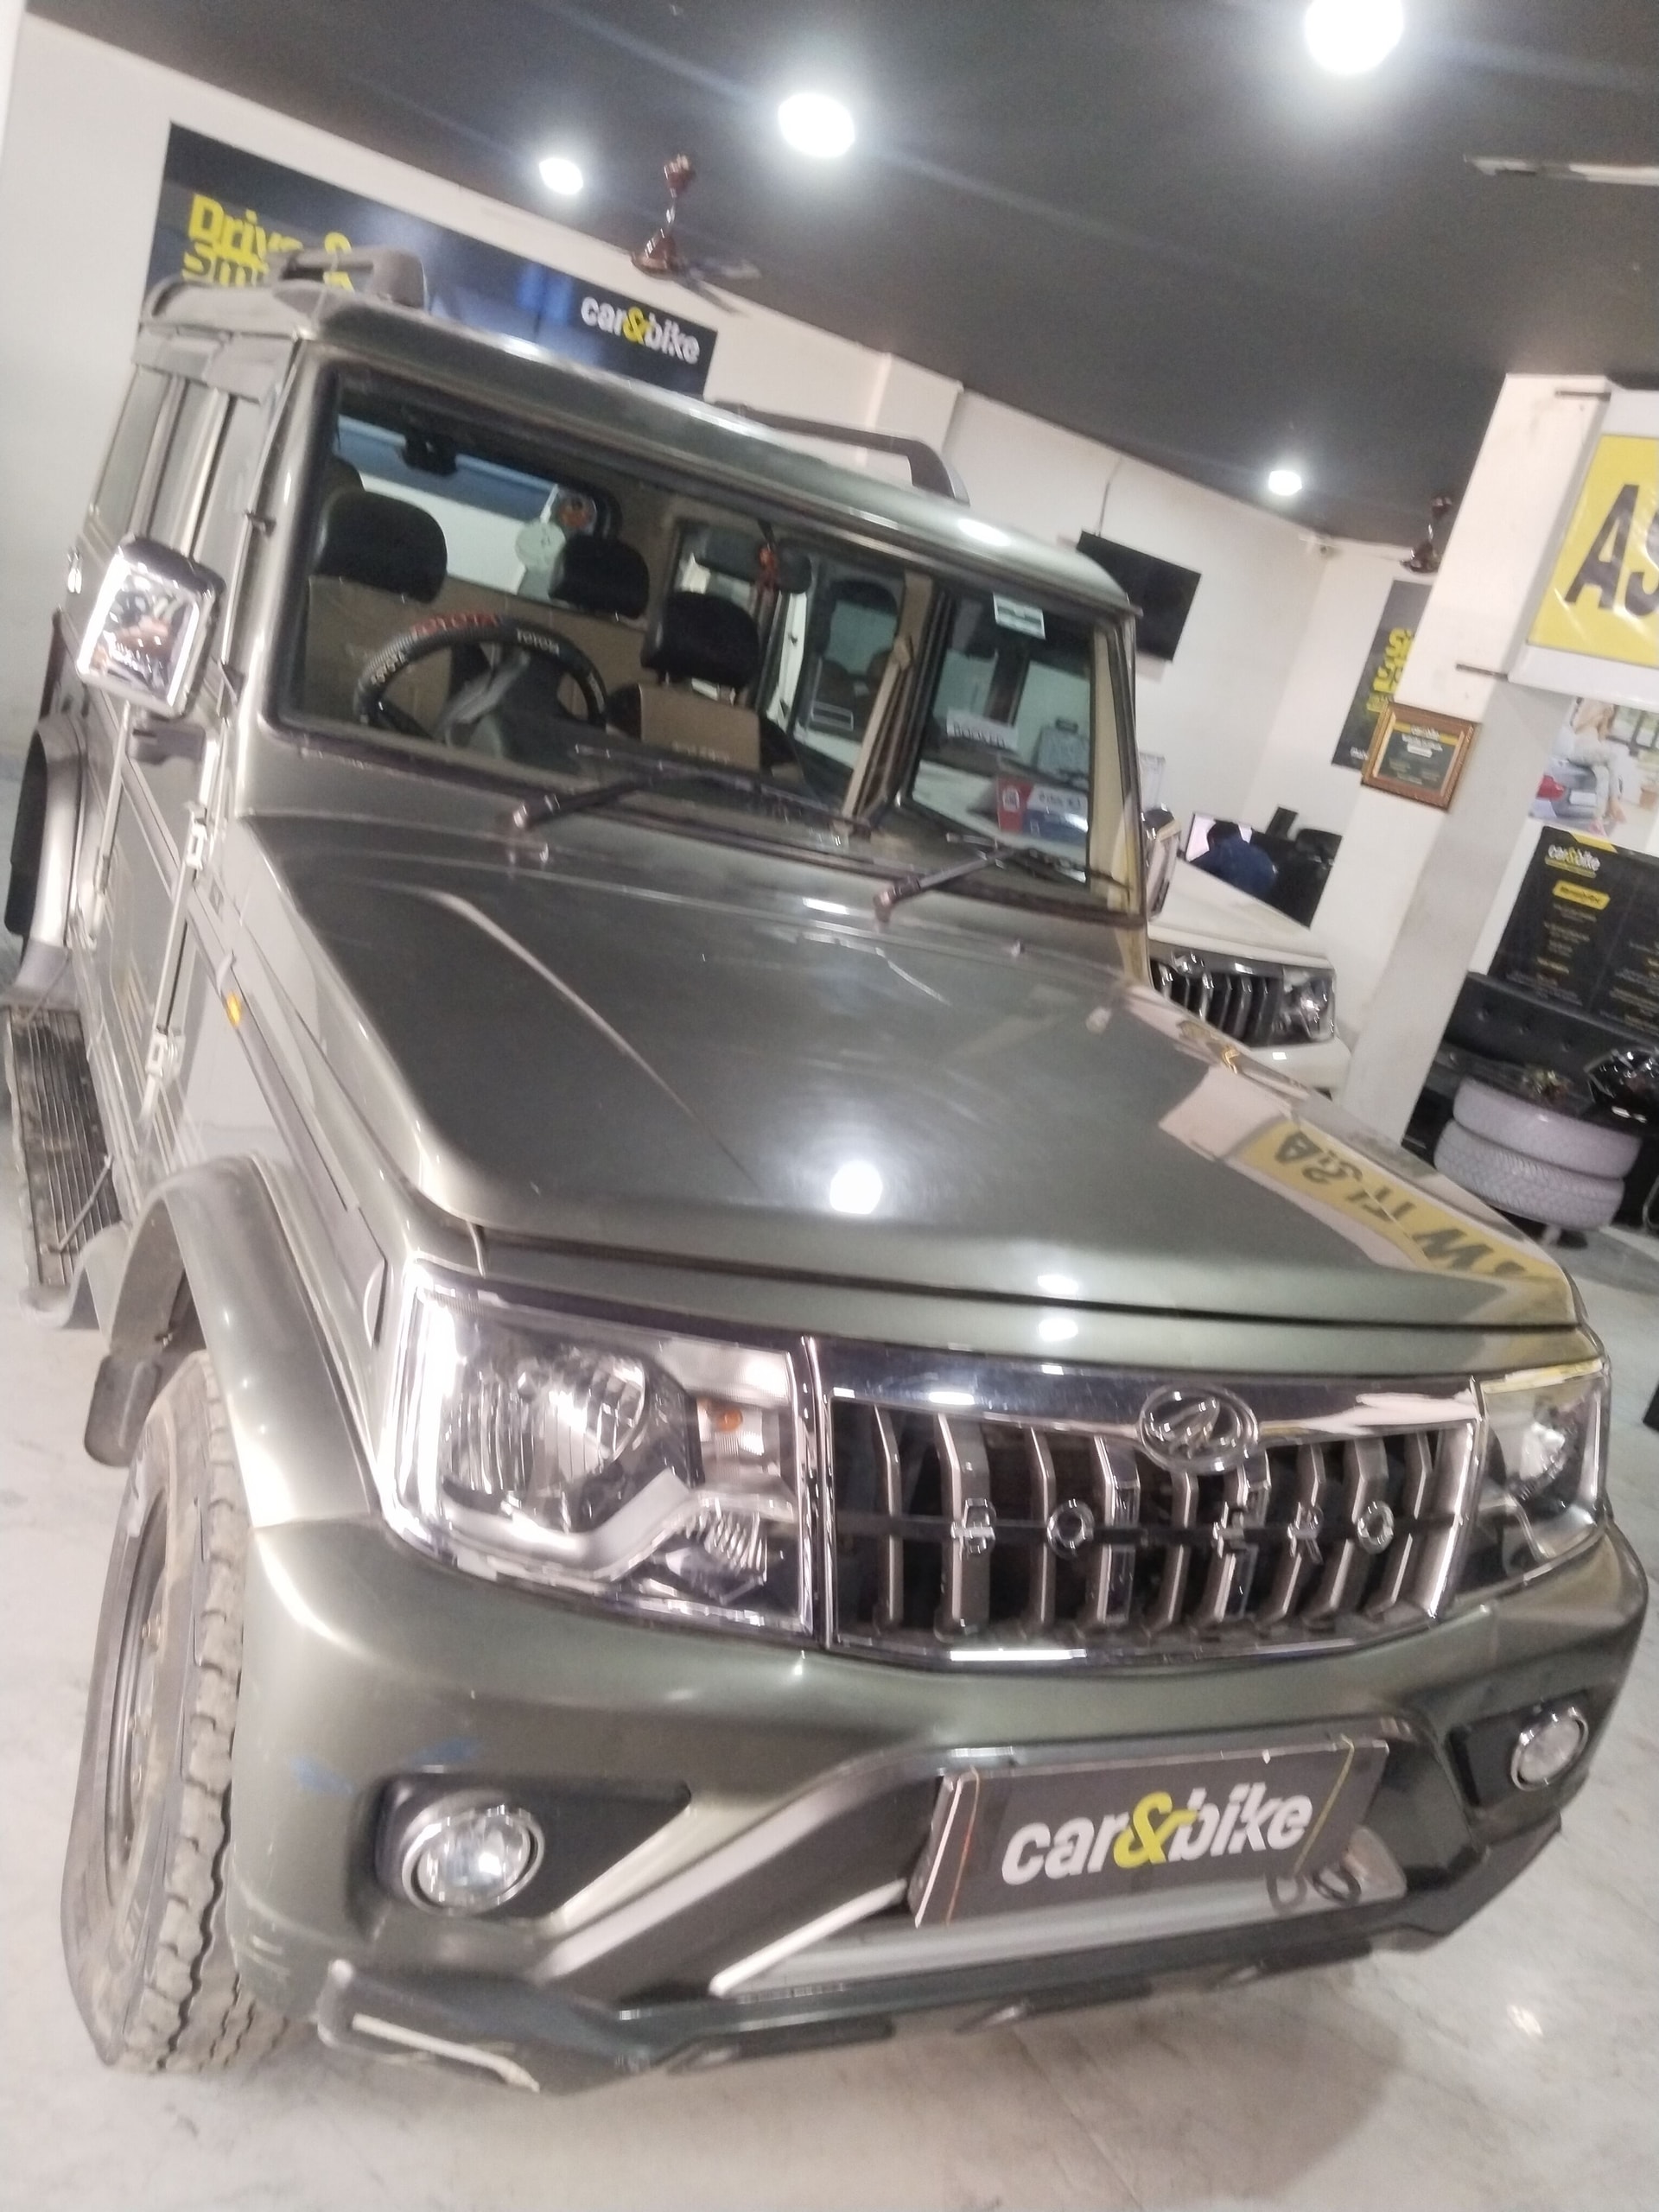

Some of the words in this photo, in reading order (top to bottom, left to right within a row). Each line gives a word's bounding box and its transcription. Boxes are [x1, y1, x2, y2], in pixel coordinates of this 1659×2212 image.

[580, 296, 701, 365] car&bike
[950, 1497, 1396, 1566] BOERO
[1001, 1781, 1313, 1885] car&bike
